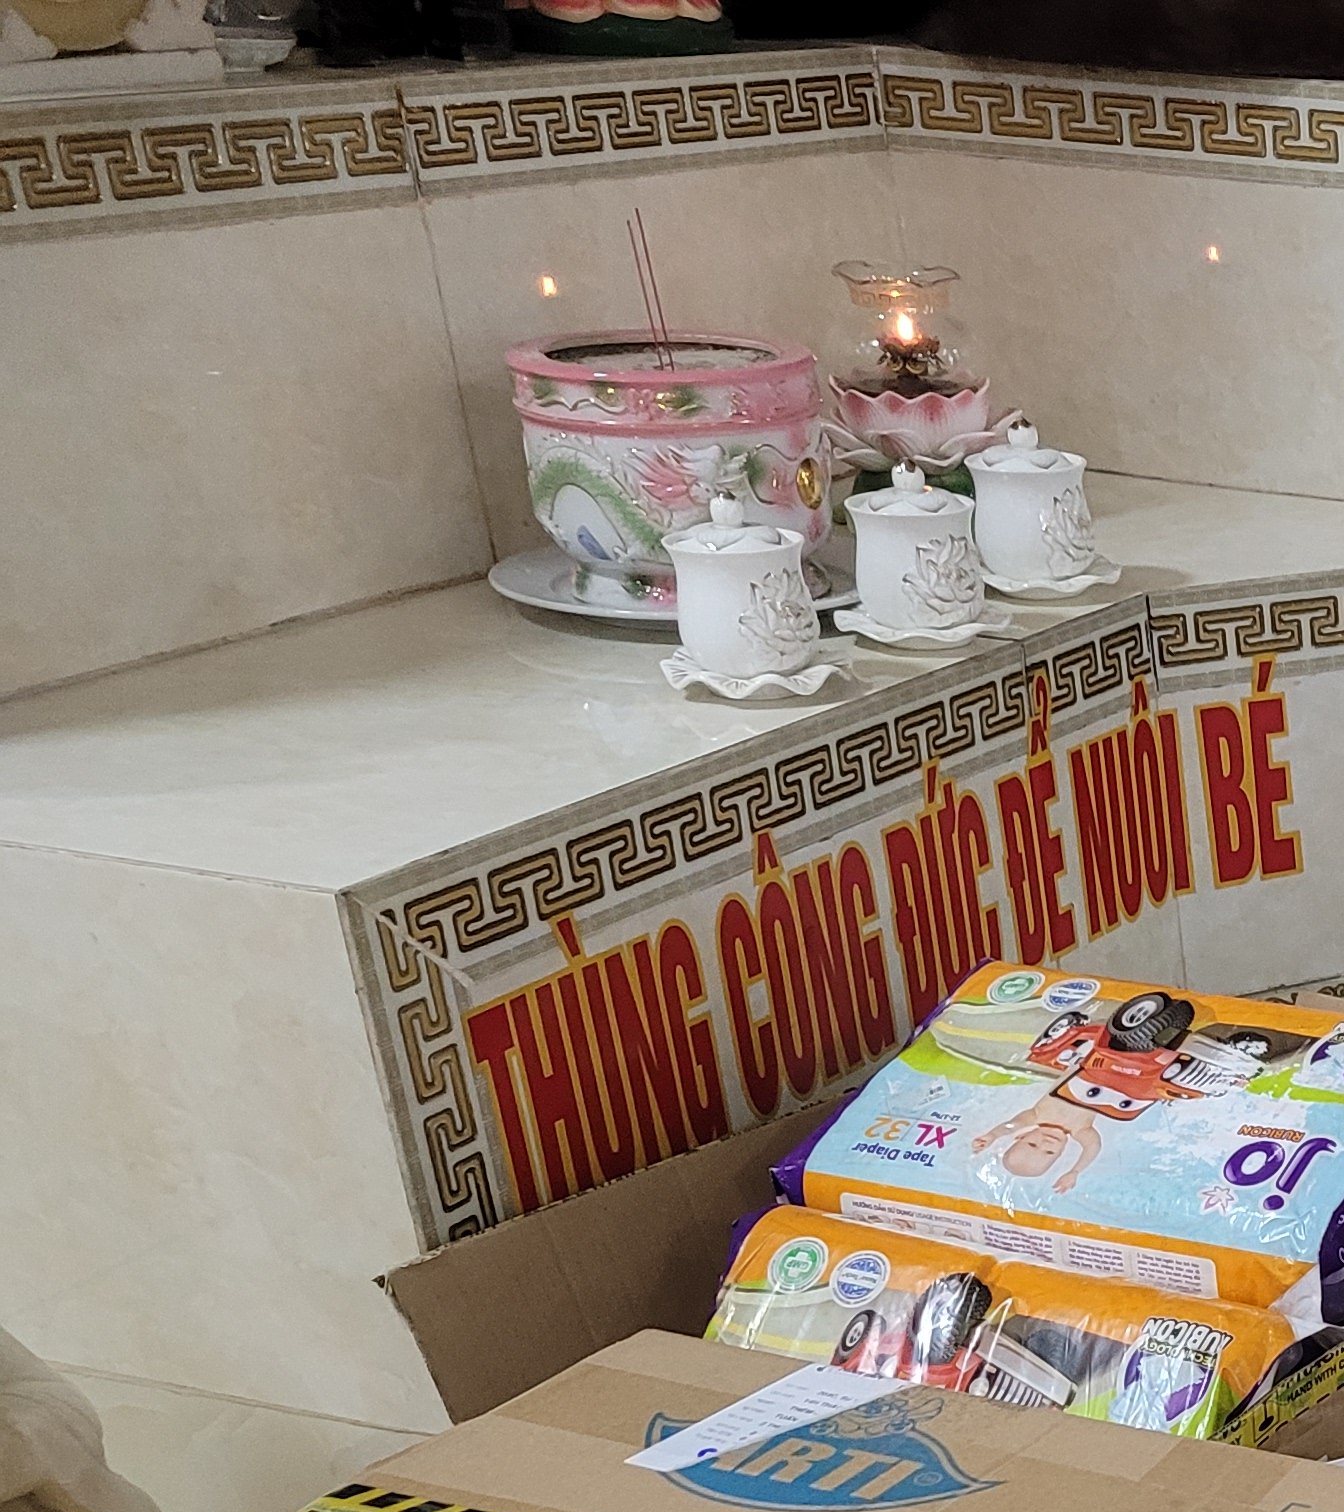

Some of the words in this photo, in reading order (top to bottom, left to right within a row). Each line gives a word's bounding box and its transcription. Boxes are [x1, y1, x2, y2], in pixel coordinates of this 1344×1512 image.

[467, 916, 732, 1212] THÙNG
[717, 830, 897, 1120] CÔNG
[882, 757, 1002, 1044] ĐỨC
[998, 676, 1077, 967] ĐỂ
[1070, 689, 1195, 942] NUÔI
[1195, 655, 1305, 888] BÉ
[863, 1116, 901, 1142] 32
[915, 1122, 958, 1150] XL
[1237, 1123, 1306, 1144] RUBICON
[851, 1140, 900, 1163] Diaper
[902, 1150, 937, 1169] Tape
[1286, 1380, 1314, 1403] HAND
[1314, 1365, 1338, 1387] WITH
